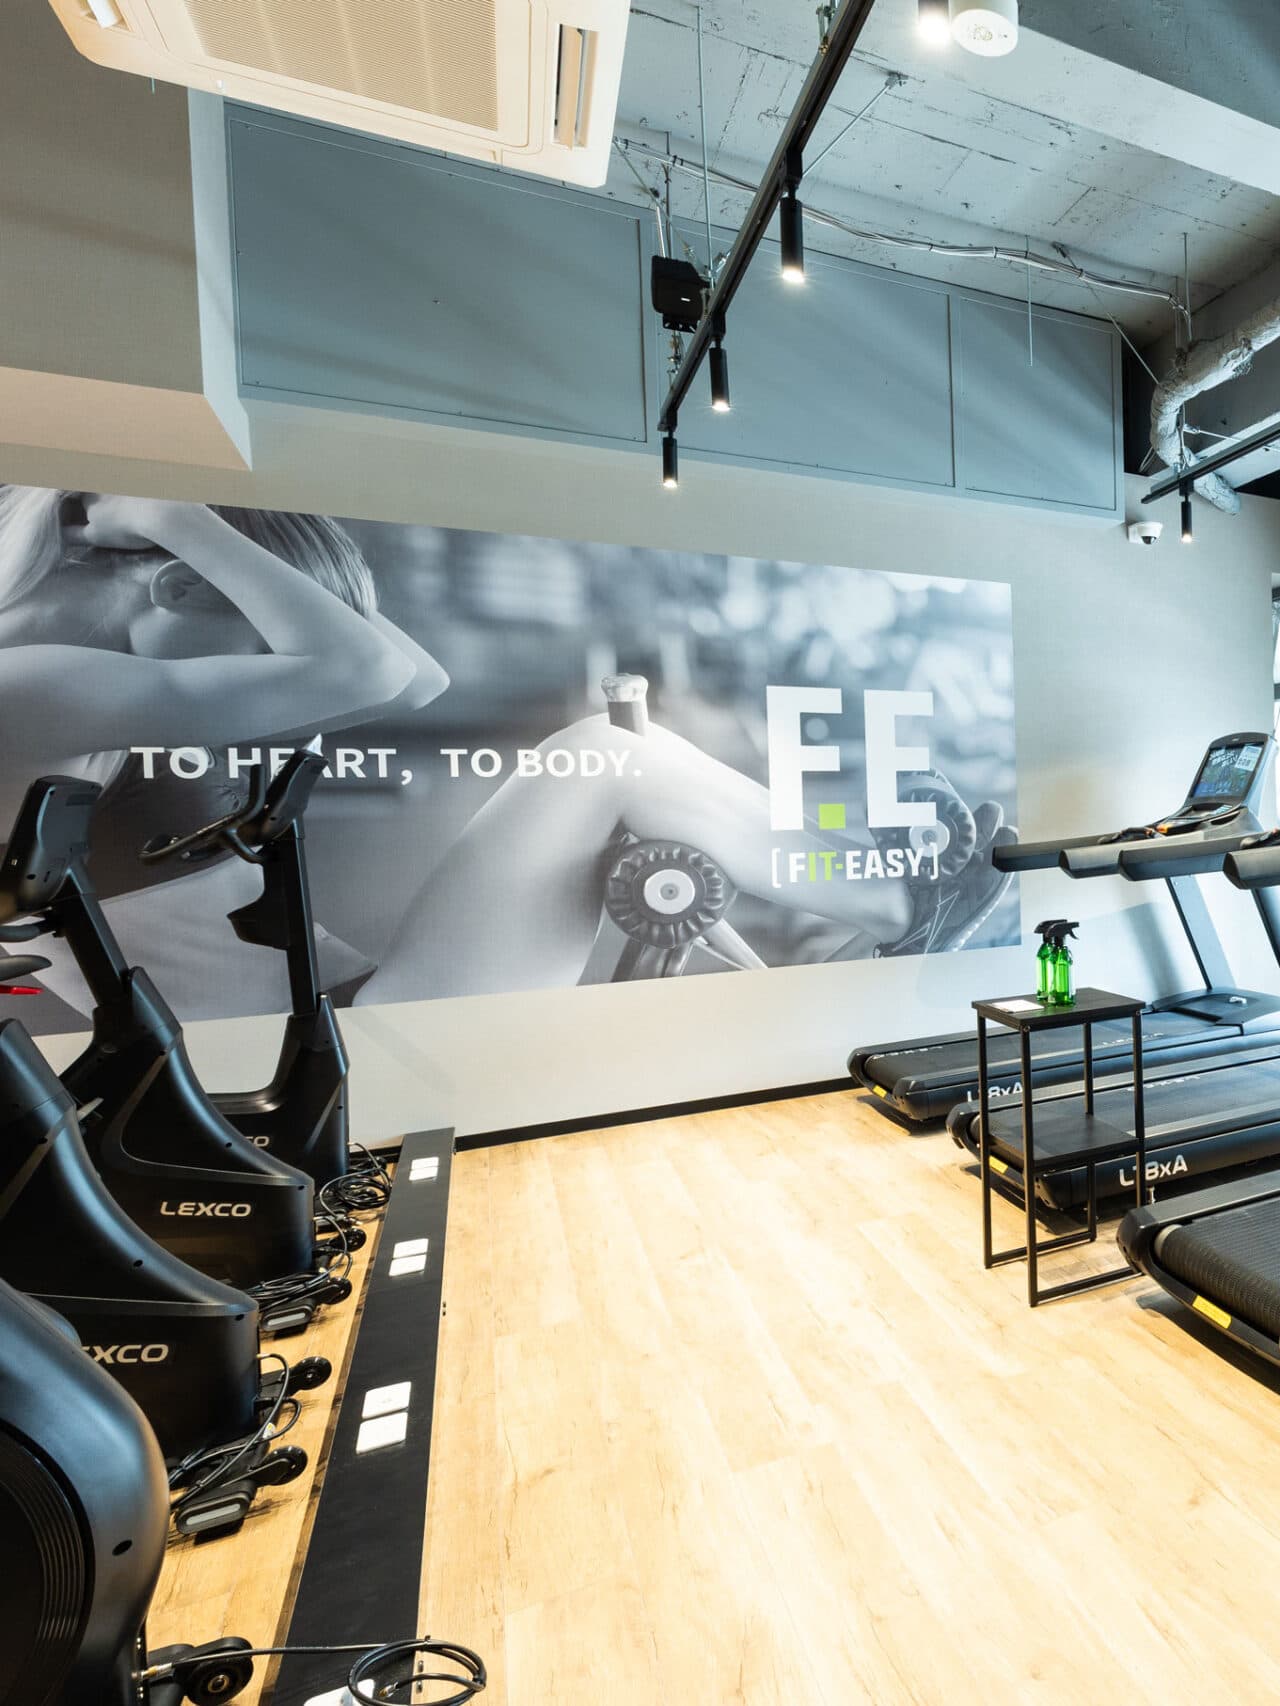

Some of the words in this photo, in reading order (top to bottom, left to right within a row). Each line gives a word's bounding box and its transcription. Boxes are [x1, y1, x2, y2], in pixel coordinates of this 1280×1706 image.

[130, 746, 209, 780] TO
[227, 747, 413, 786] HERT,
[440, 748, 502, 778] TO
[517, 749, 642, 778] BODY.
[1119, 1154, 1188, 1186] L8xA
[160, 1201, 252, 1217] LEXCO
